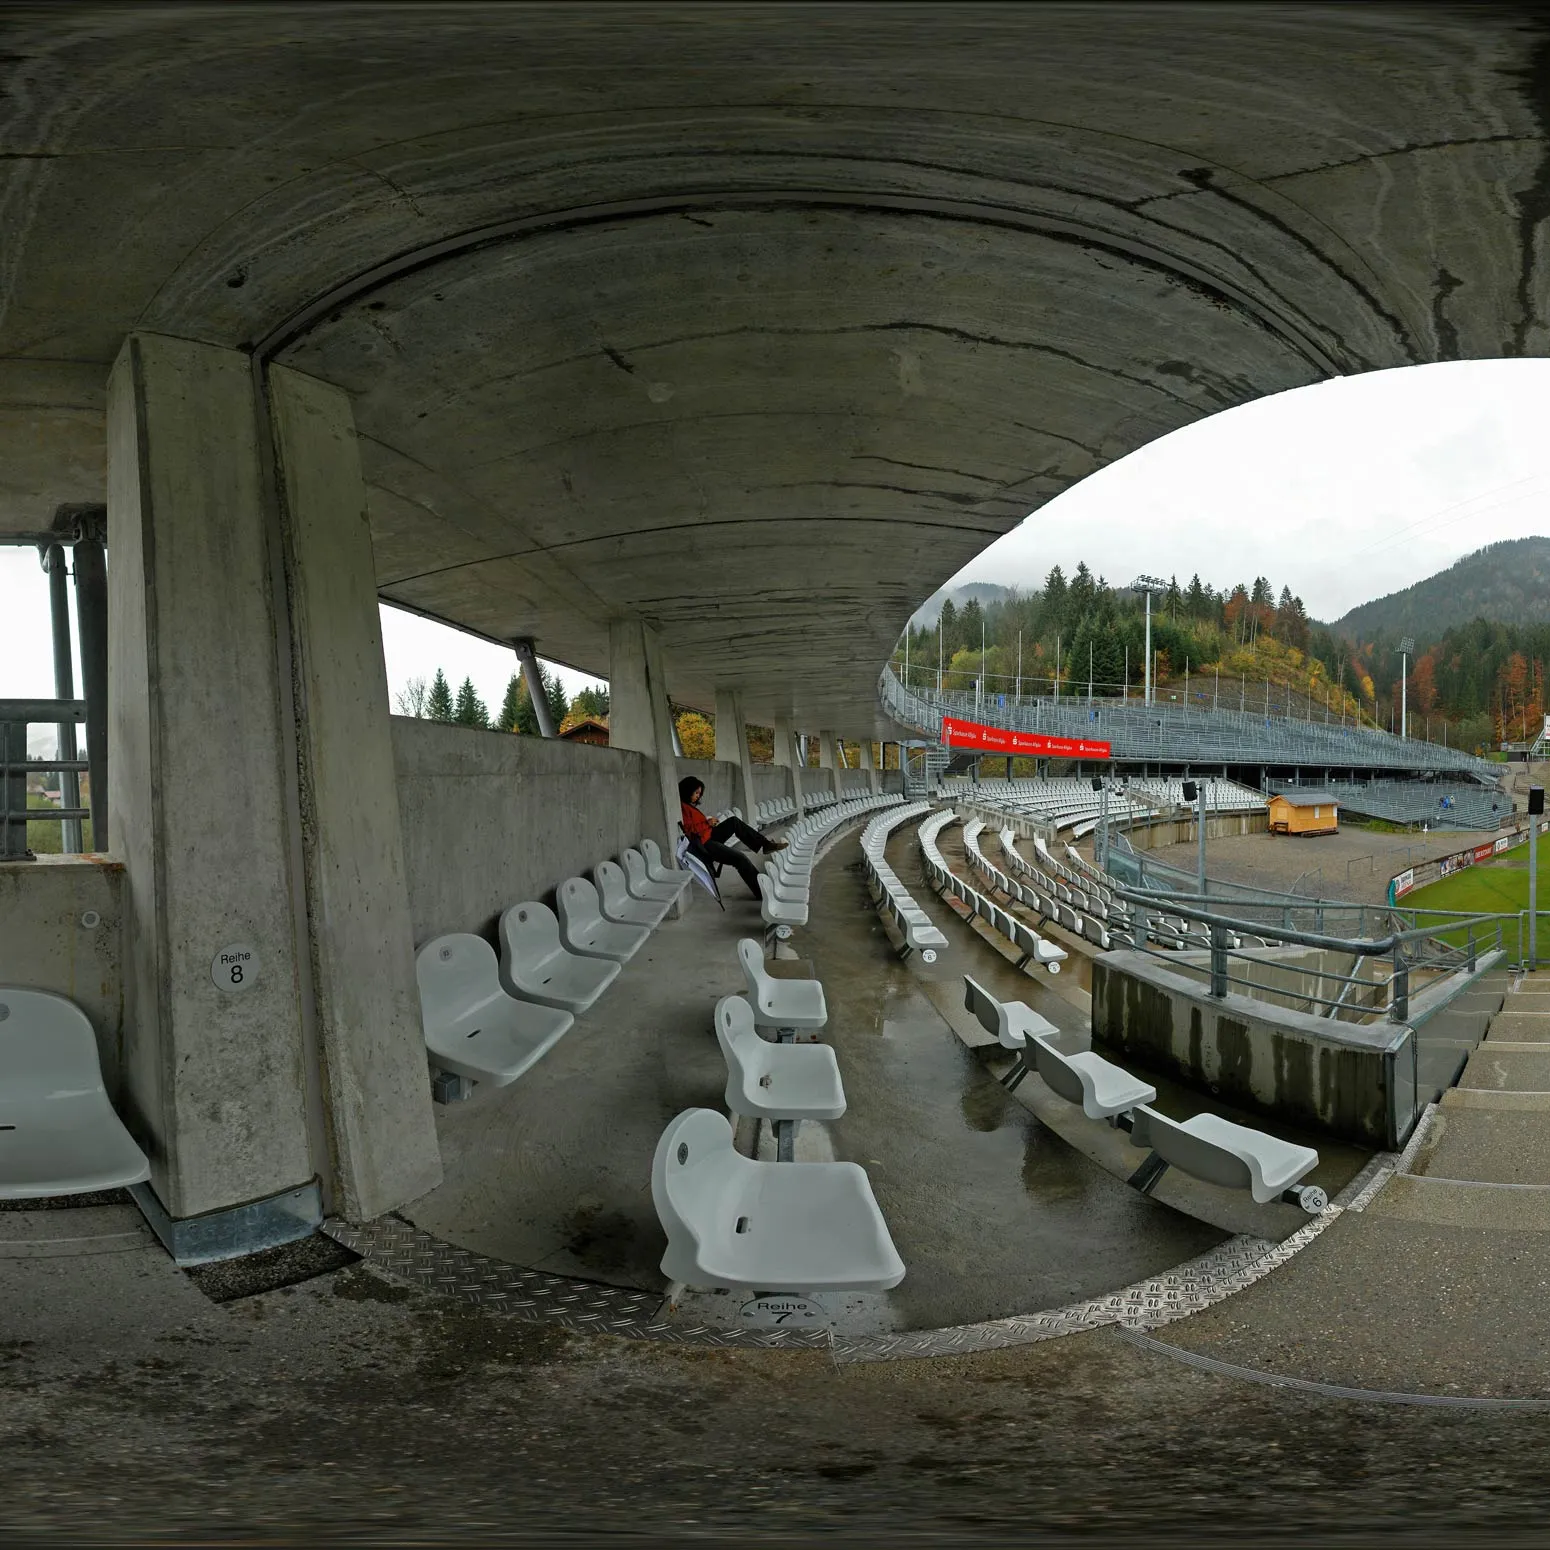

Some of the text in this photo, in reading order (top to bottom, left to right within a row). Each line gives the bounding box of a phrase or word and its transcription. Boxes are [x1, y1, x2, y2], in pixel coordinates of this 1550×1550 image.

[221, 952, 251, 965] Reihe
[231, 965, 243, 984] 8
[1313, 1197, 1322, 1207] 6
[771, 1311, 793, 1324] 7
